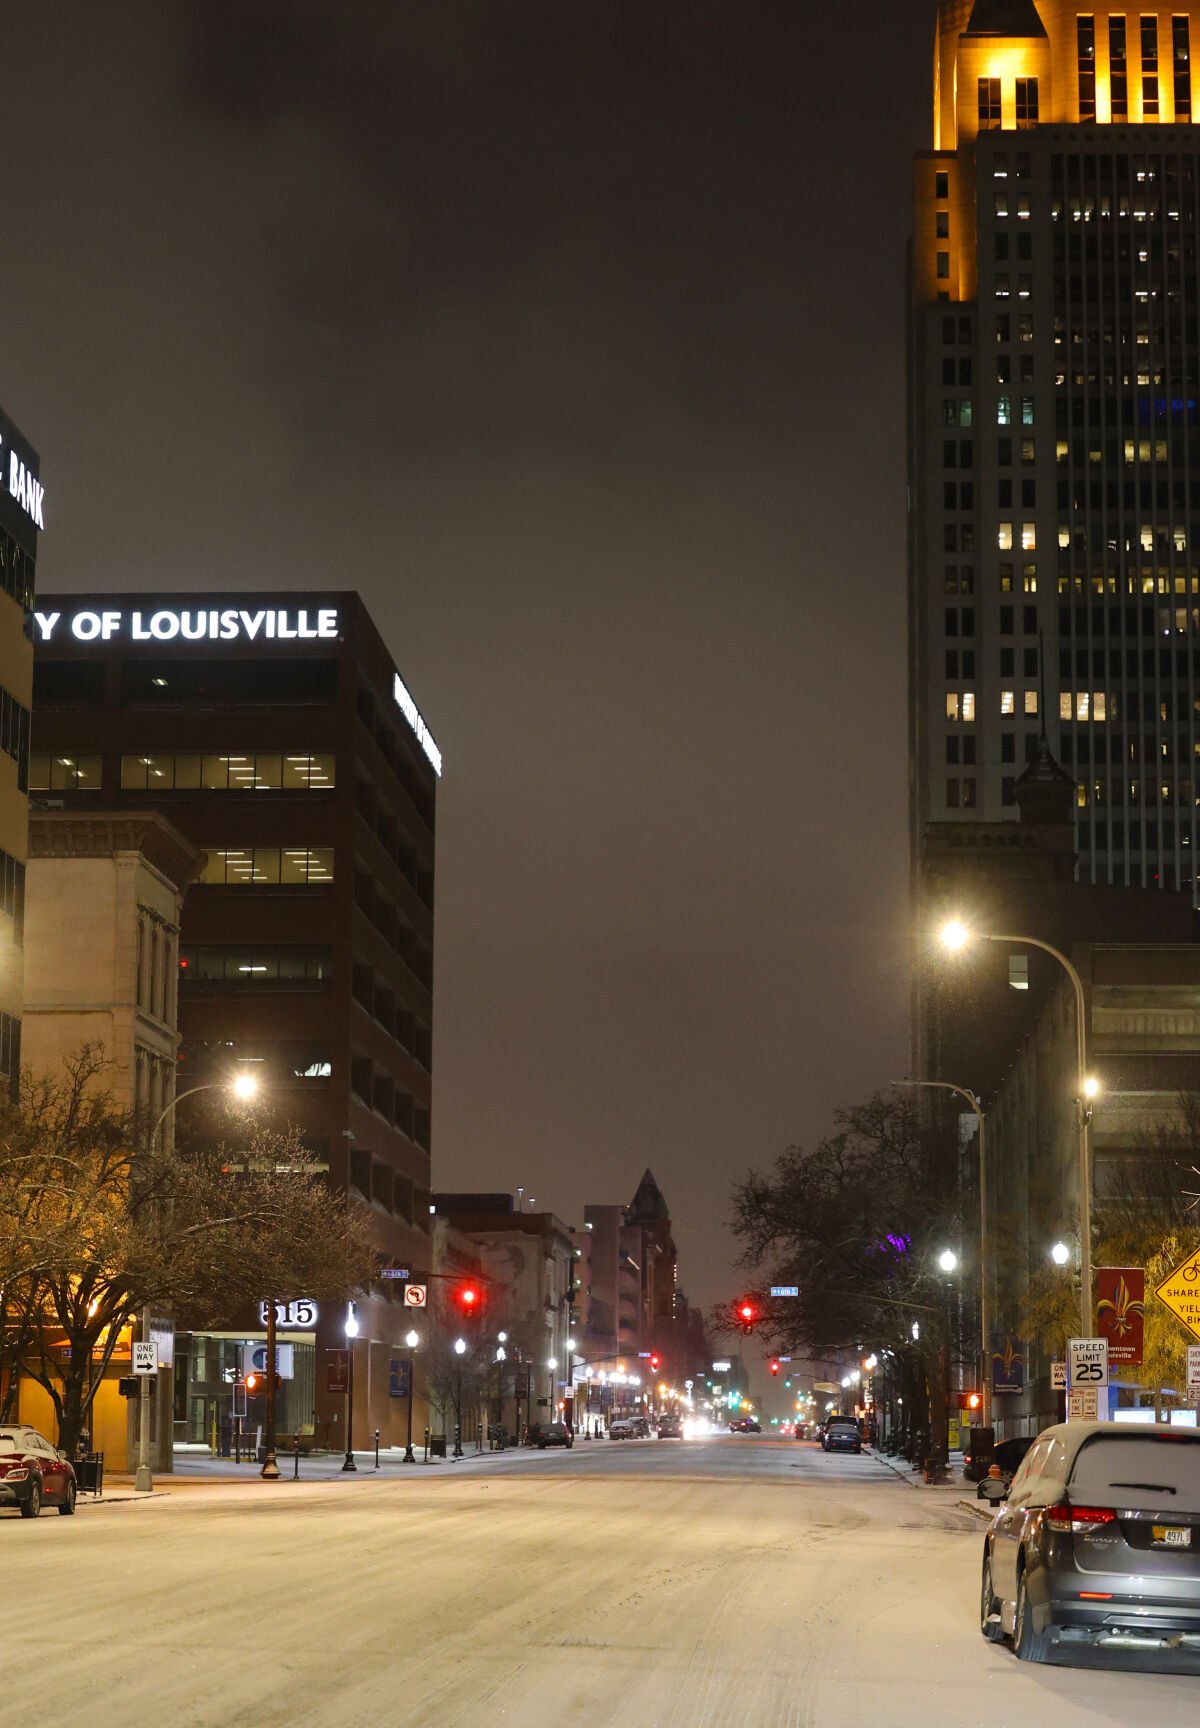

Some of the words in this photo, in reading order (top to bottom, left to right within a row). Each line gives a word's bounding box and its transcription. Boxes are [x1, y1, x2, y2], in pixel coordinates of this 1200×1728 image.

[9, 449, 45, 530] BANK
[71, 611, 122, 640] OF
[132, 609, 339, 640] LOUISVILLE
[1166, 1289, 1200, 1297] SHARE
[136, 1344, 154, 1352] ONE
[1072, 1343, 1105, 1351] SPEED
[136, 1353, 154, 1361] WAY
[1076, 1353, 1101, 1362] LIMIT
[1075, 1363, 1103, 1381] 25
